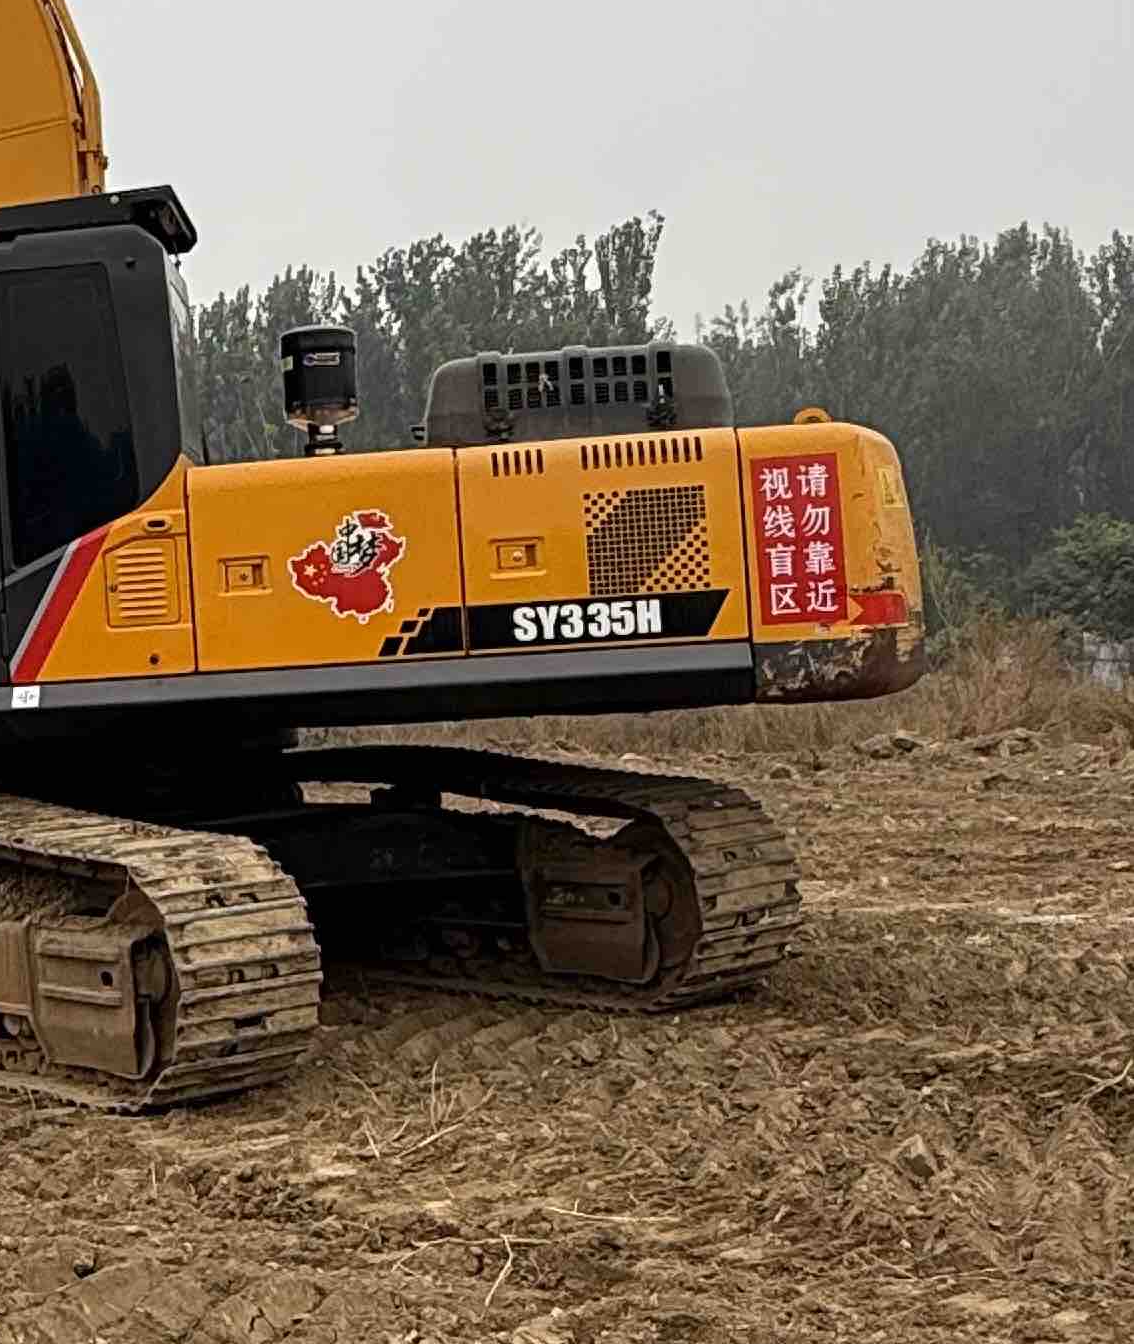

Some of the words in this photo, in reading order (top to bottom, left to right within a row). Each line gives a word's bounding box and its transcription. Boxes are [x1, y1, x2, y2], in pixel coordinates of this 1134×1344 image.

[759, 465, 801, 615] 视线盲区
[797, 463, 839, 613] 请勿靠近
[512, 599, 662, 642] SY335H
